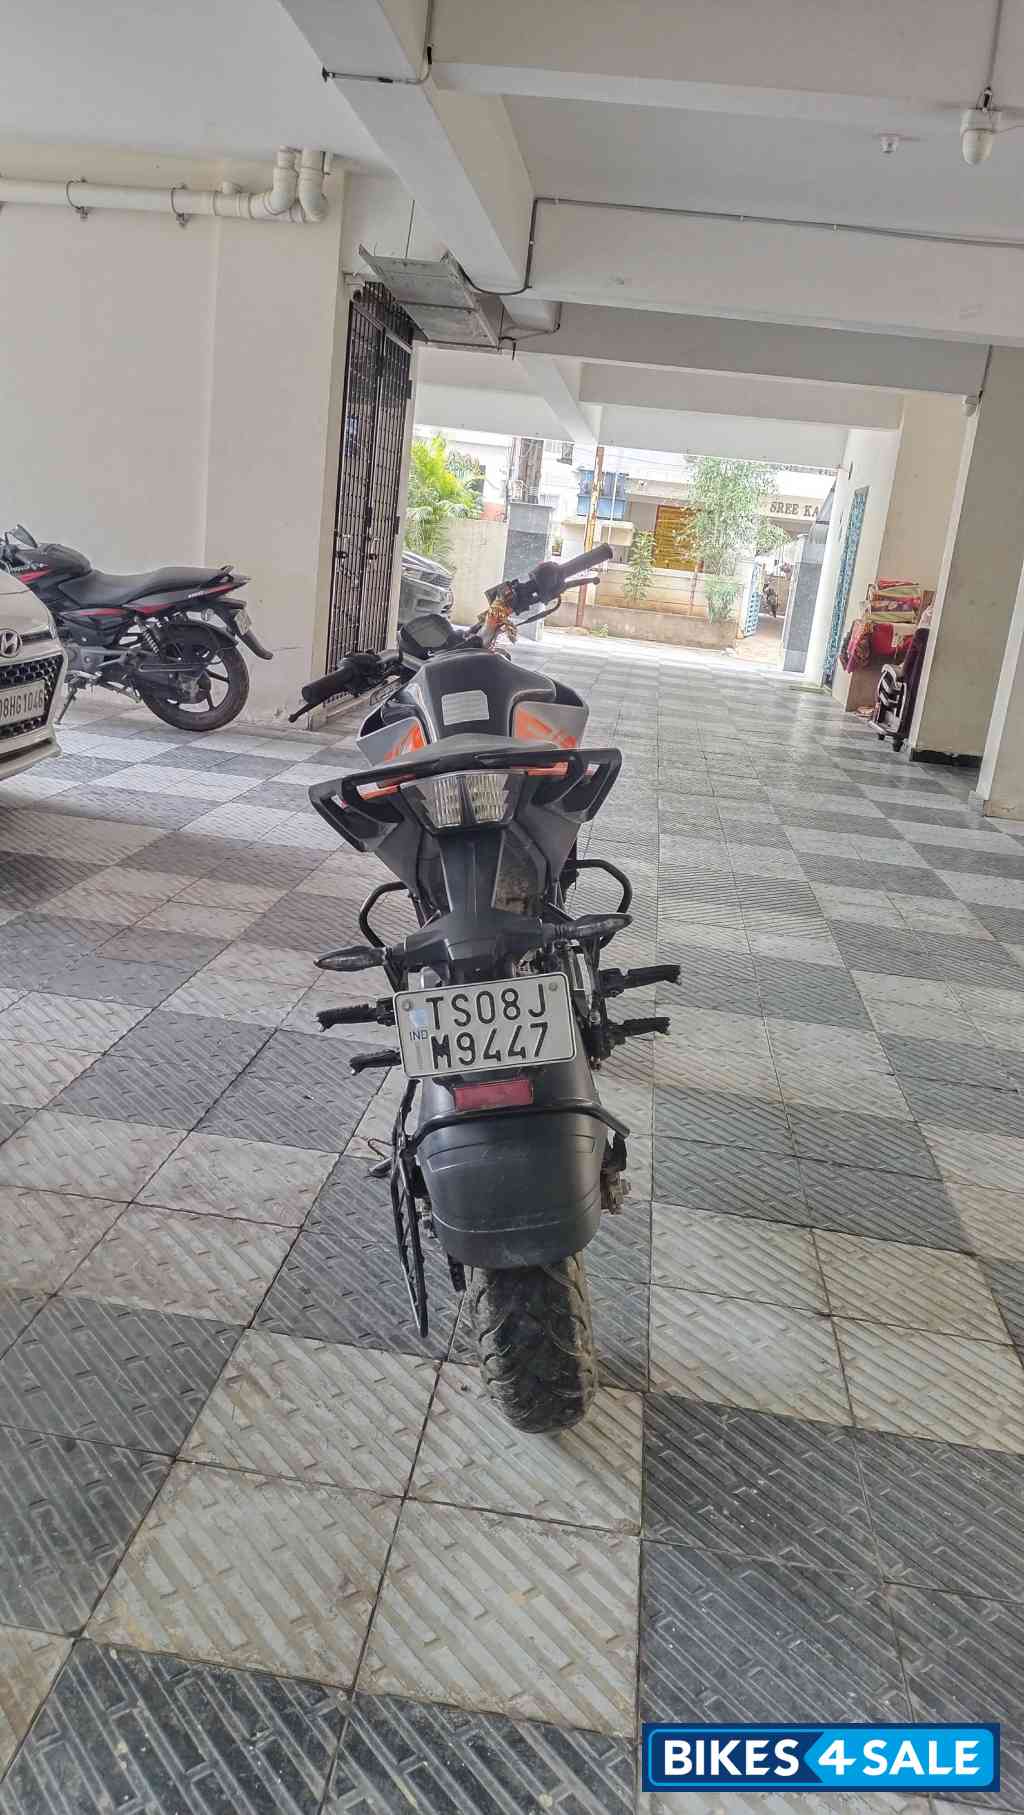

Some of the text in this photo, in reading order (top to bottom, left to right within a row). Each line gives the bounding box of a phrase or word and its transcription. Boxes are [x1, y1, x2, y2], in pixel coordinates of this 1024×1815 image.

[769, 501, 799, 515] SREE
[425, 983, 547, 1030] TS08J
[409, 1030, 428, 1041] IND
[430, 1021, 549, 1070] M9447
